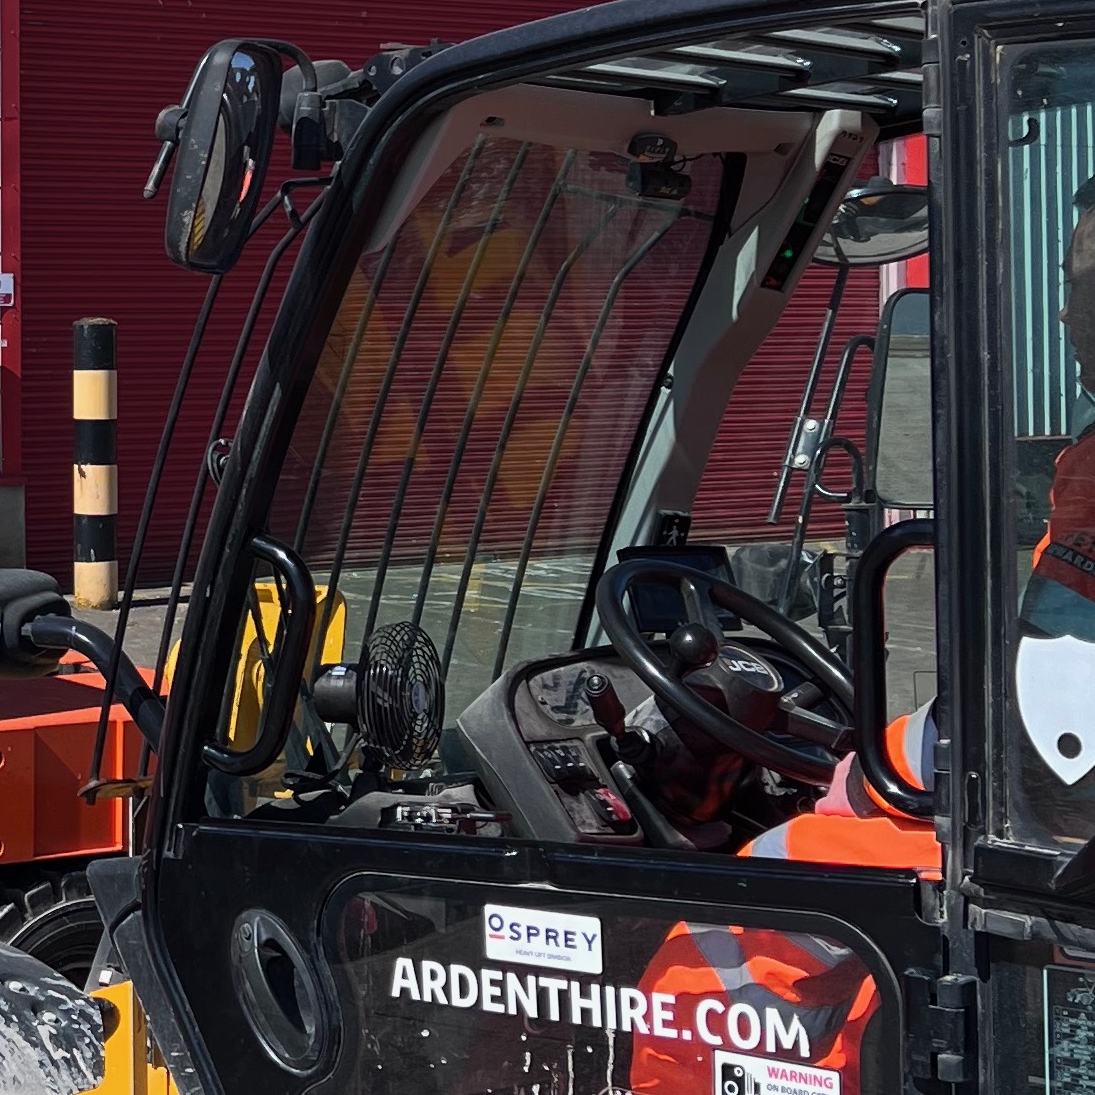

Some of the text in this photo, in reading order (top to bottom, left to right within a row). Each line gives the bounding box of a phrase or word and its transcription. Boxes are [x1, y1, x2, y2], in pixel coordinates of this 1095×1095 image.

[729, 660, 769, 675] JCB
[488, 913, 597, 952] OSPREY
[391, 957, 810, 1058] ARDENTHIRE.COM
[766, 1083, 779, 1093] ON
[767, 1065, 834, 1090] WARNING
